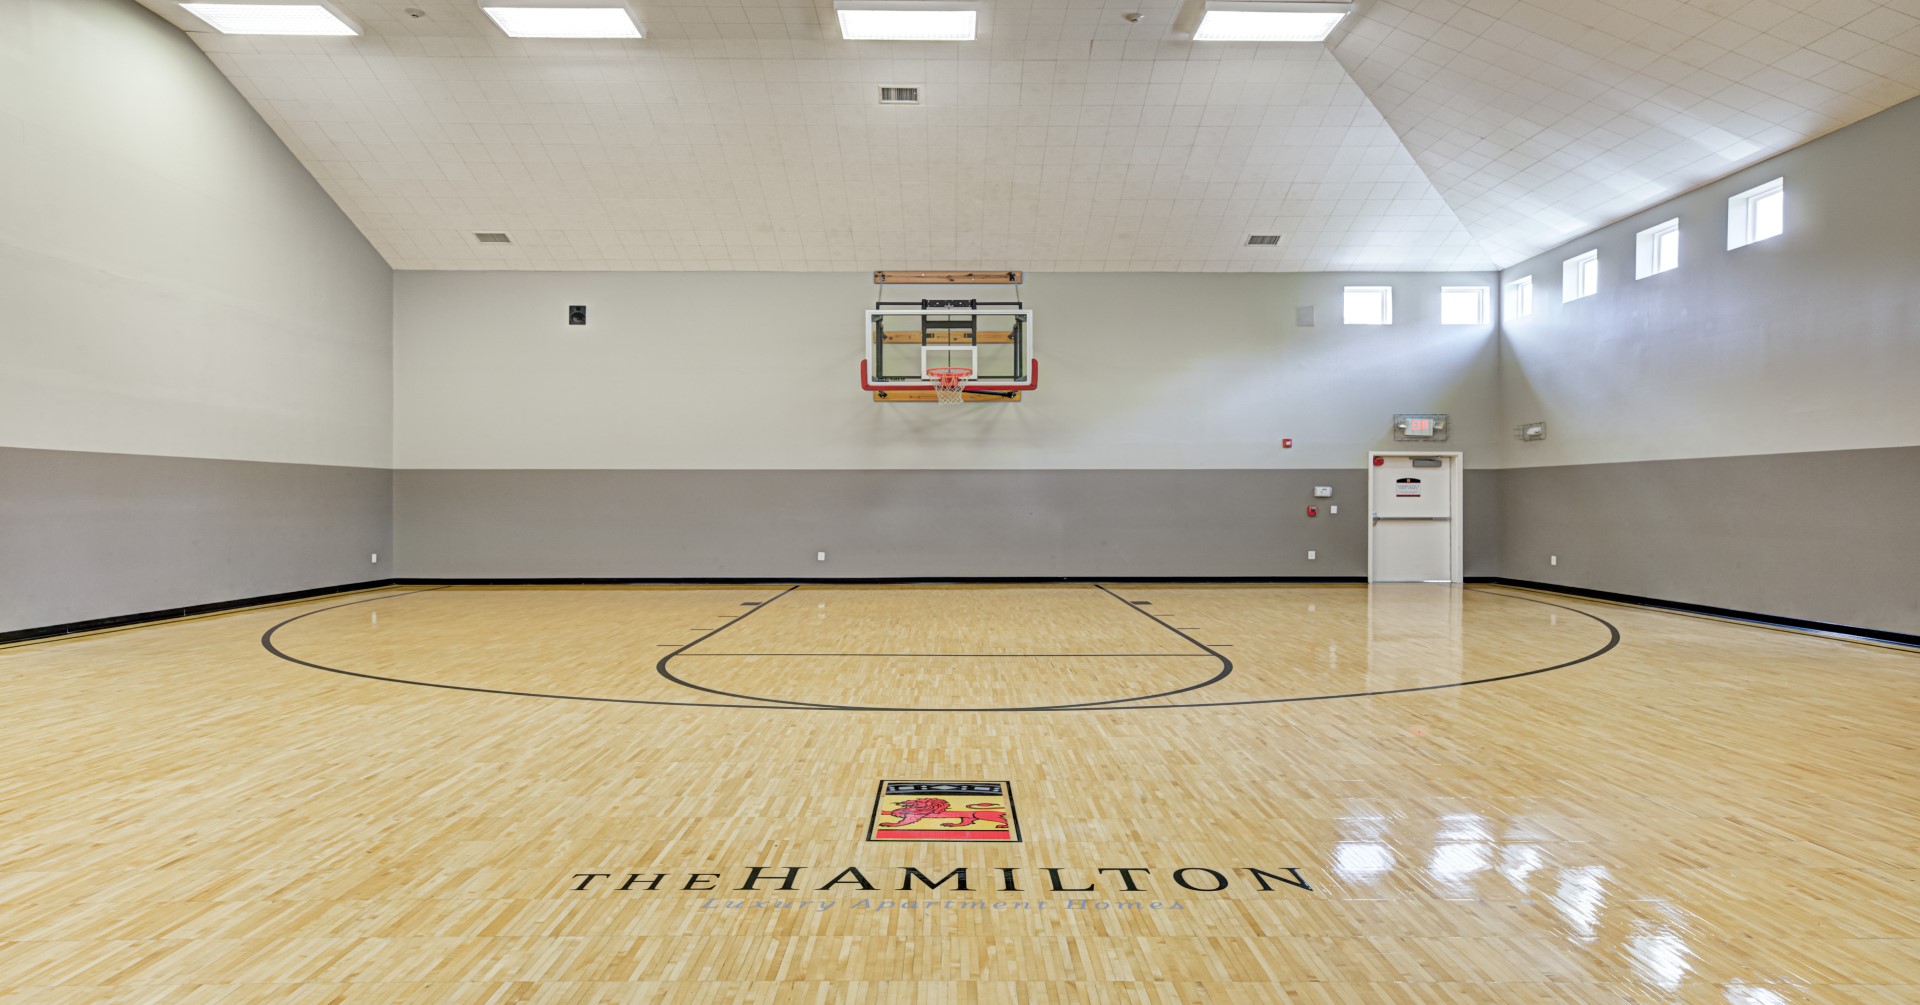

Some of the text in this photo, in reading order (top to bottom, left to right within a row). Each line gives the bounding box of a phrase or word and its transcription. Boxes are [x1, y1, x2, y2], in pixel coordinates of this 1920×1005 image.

[568, 866, 1314, 892] THE HAMILTON
[700, 897, 1185, 912] Luxury Apartment Homes
